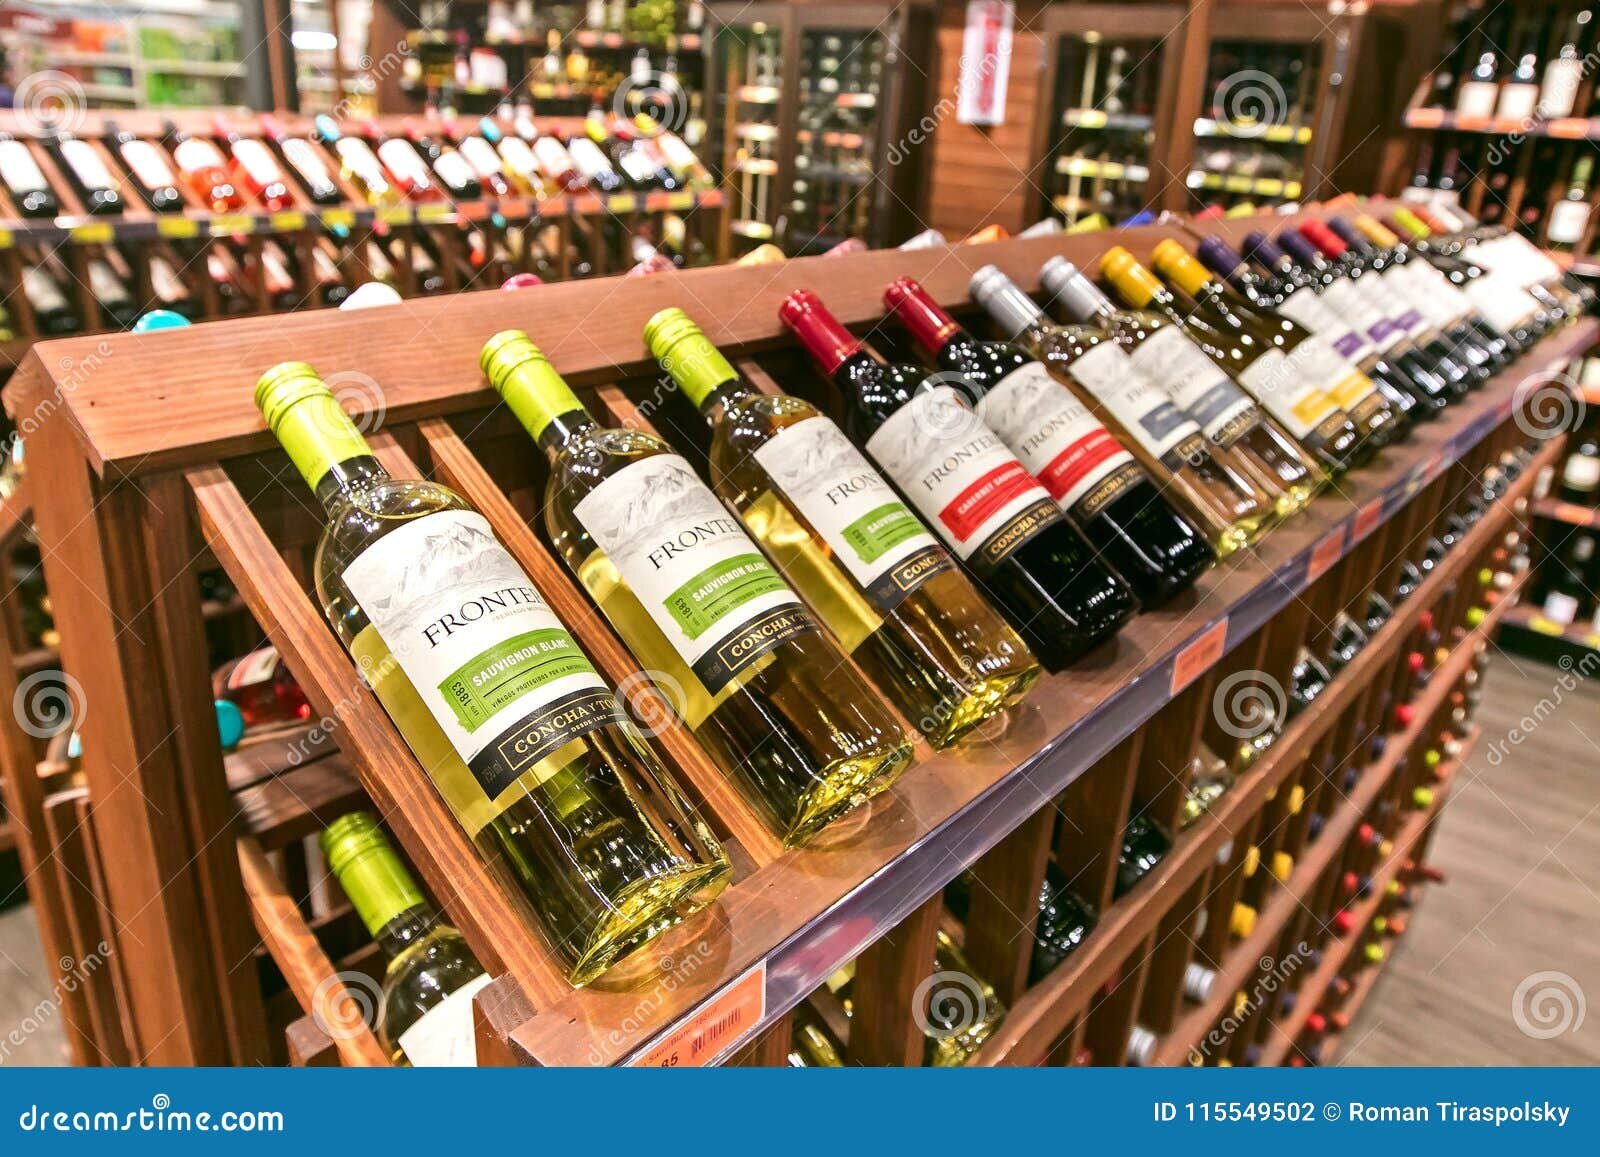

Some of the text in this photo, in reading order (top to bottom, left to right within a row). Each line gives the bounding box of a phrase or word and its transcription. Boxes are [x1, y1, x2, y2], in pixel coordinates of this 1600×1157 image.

[991, 516, 1036, 555] CONCHA
[692, 561, 769, 602] SAUVIGNON BLANC
[675, 597, 695, 620] 1883
[731, 617, 791, 657] CONCHA
[472, 638, 570, 688] SAUVIGNON BLANC
[516, 673, 549, 692] PROTEGIDOS
[451, 681, 470, 707] 1883
[514, 705, 590, 754] CONCHA
[587, 702, 596, 712] Y
[571, 719, 593, 733] DESDE
